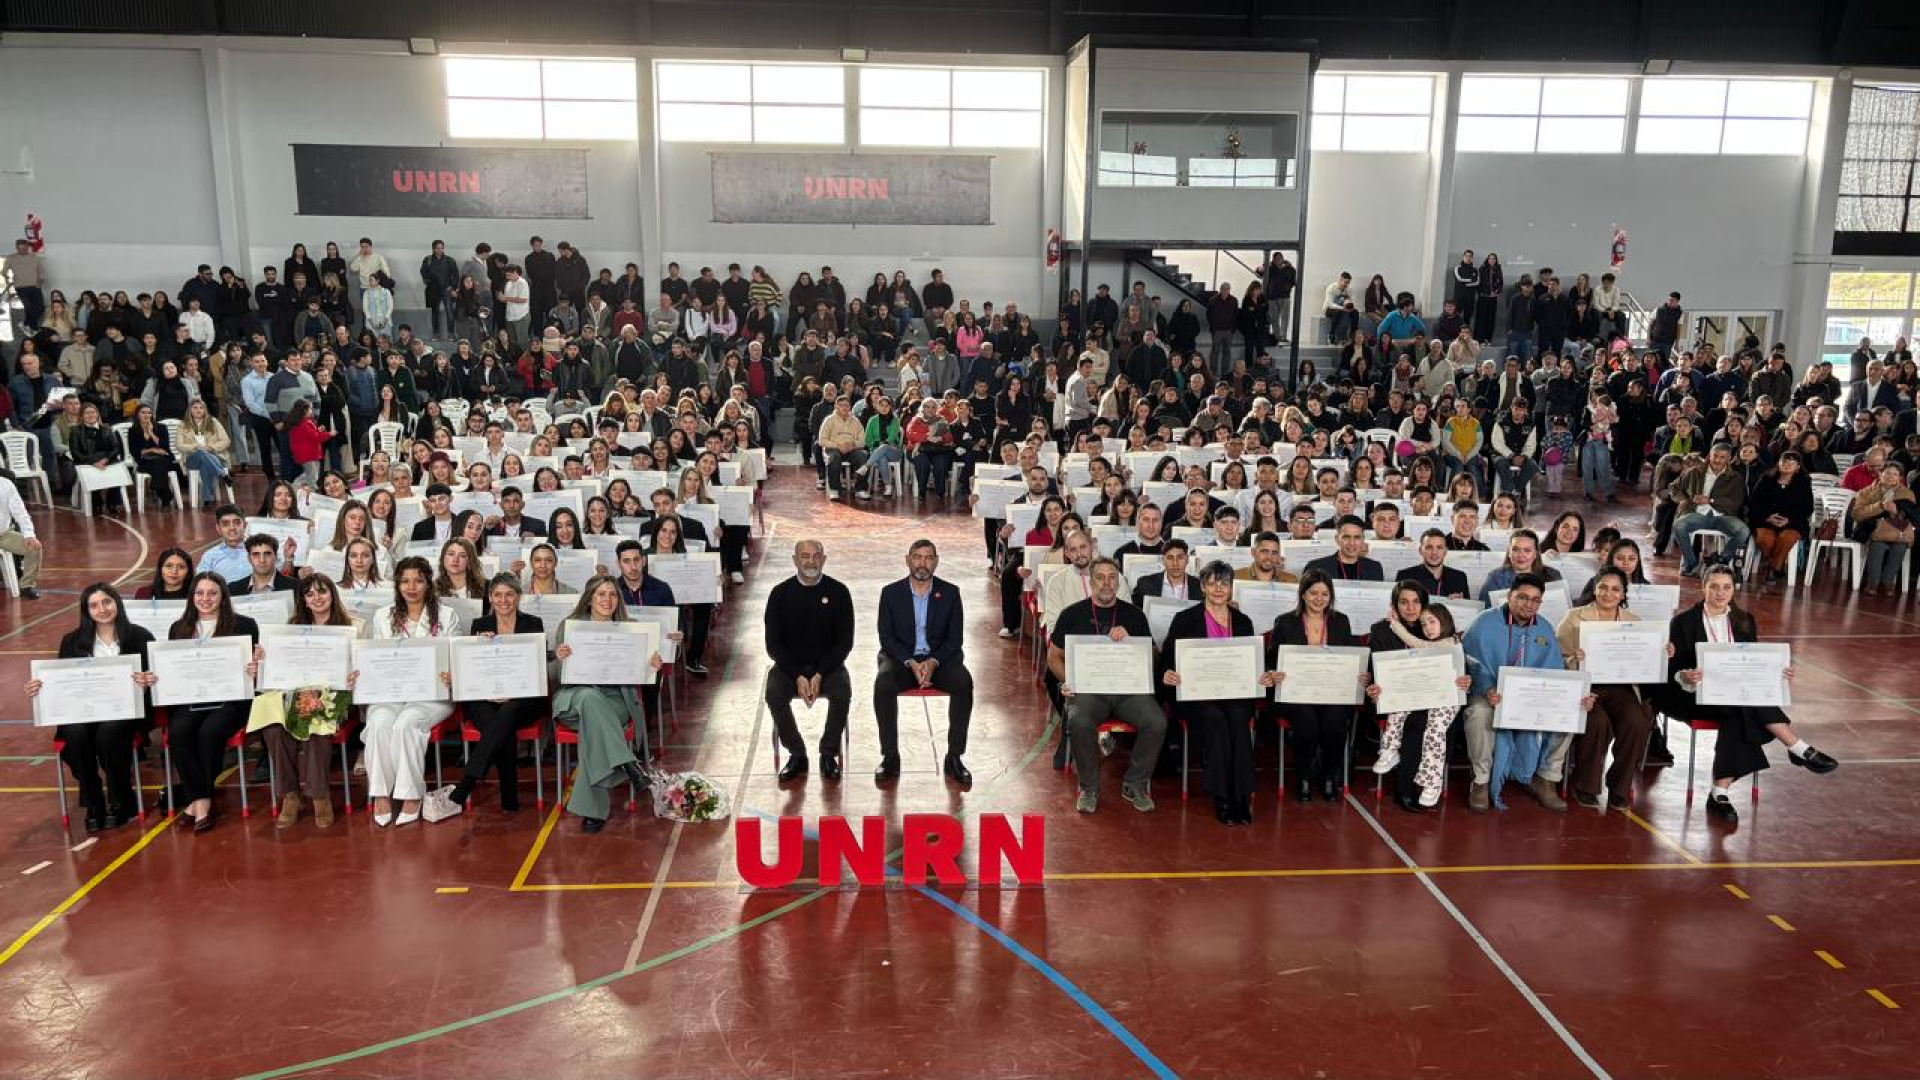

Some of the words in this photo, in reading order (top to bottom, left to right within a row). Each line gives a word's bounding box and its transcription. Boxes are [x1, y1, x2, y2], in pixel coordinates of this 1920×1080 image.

[393, 170, 480, 192] UNRN
[804, 177, 888, 200] UNRN
[735, 813, 1044, 887] UNRN
